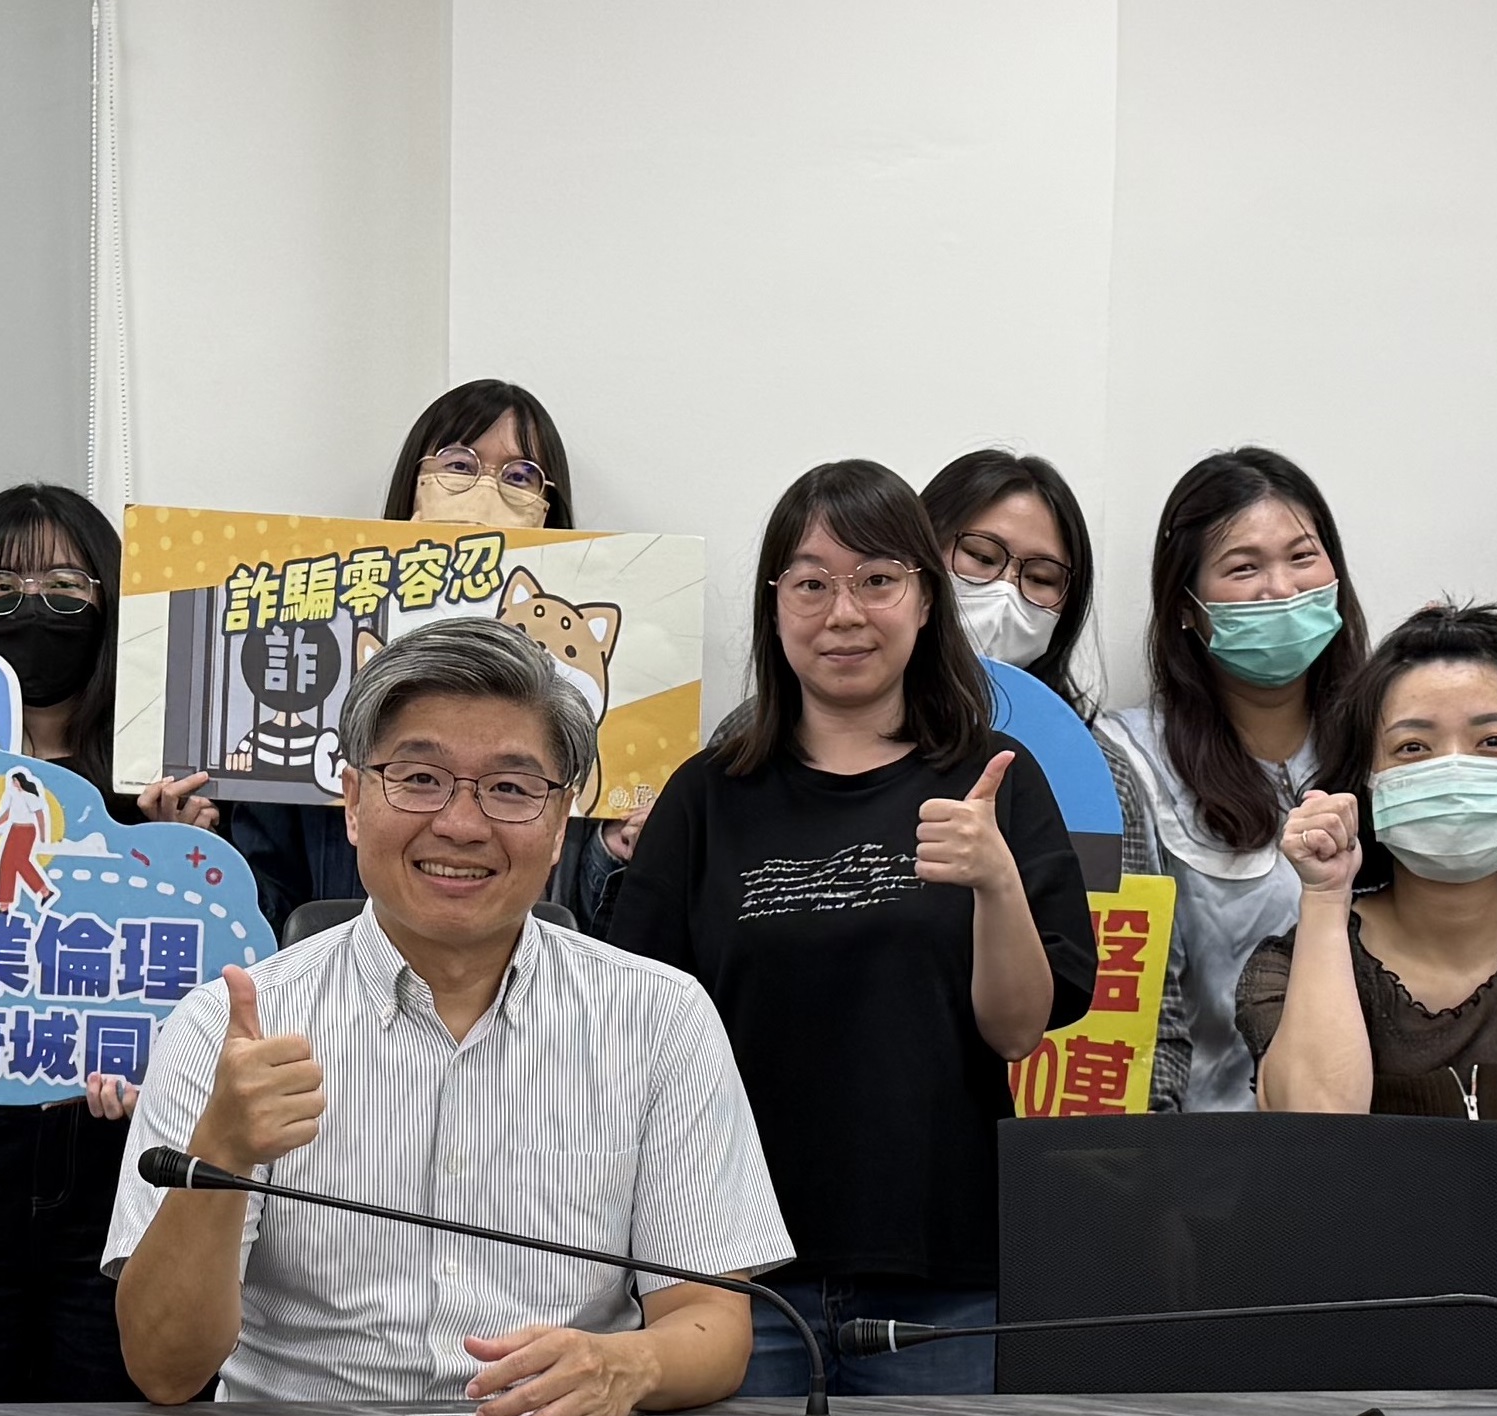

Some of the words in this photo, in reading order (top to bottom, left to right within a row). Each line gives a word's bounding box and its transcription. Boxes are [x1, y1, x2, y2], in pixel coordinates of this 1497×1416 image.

[225, 533, 504, 632] 詐騙零容忍
[265, 626, 316, 693] 詐
